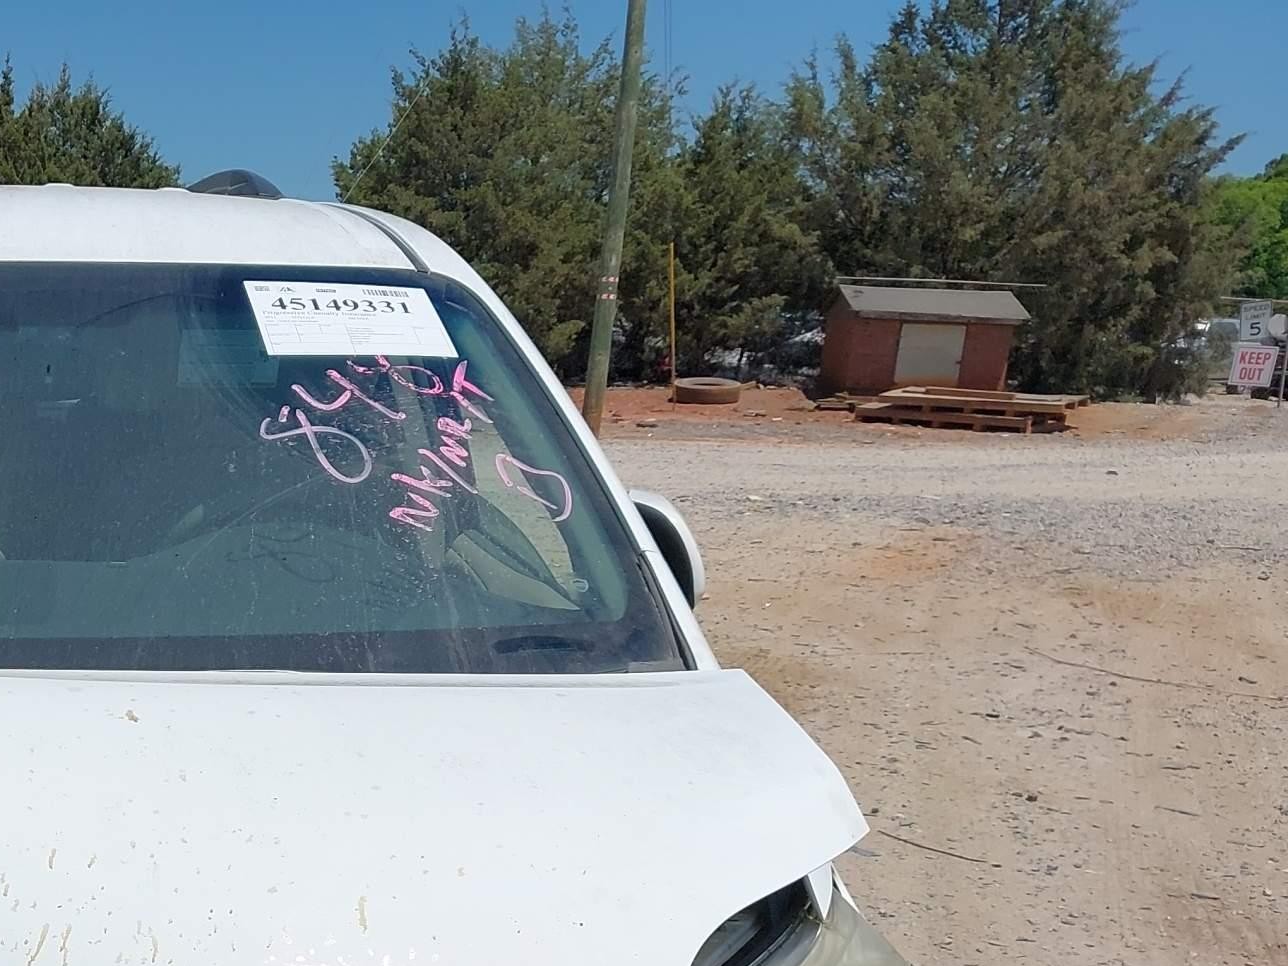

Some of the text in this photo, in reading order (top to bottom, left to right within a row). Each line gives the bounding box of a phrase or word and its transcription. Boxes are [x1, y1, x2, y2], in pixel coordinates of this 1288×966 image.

[271, 297, 411, 314] 45149331
[1249, 321, 1262, 336] 5
[1239, 350, 1272, 366] KEEP
[1239, 367, 1265, 382] OUT
